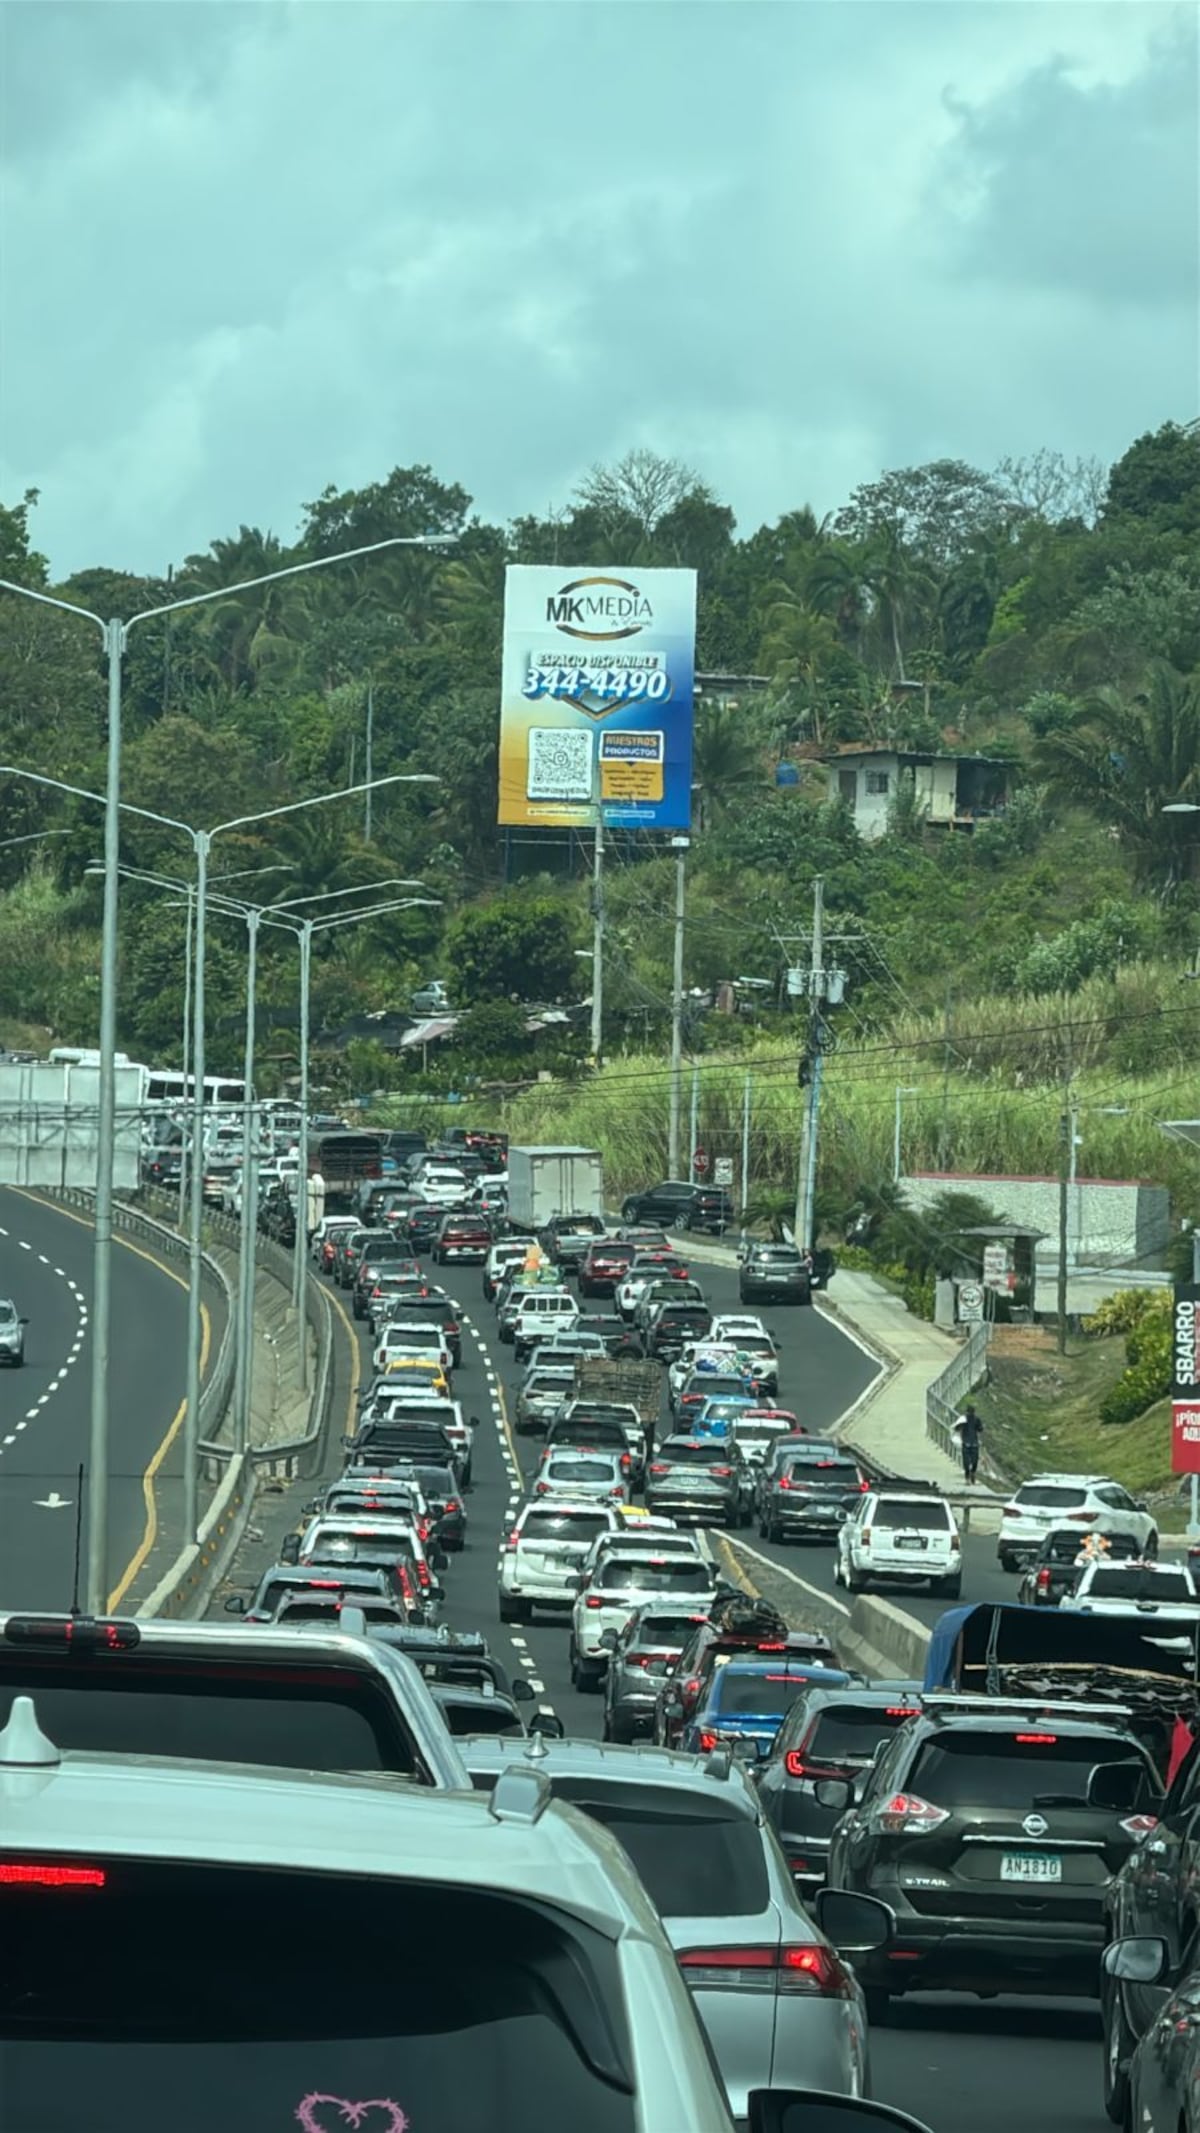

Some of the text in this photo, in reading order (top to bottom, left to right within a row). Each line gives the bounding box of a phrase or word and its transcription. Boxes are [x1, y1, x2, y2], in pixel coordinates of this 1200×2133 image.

[538, 655, 659, 669] ESPACIO DISPONIBLE
[523, 669, 667, 698] 344-4490
[605, 736, 657, 747] NUESTROS
[604, 746, 657, 757] PRODUCTOS
[1176, 1301, 1194, 1385] SBARRO
[1176, 1411, 1200, 1427] ¡PÍD
[1006, 1859, 1057, 1875] AN1810
